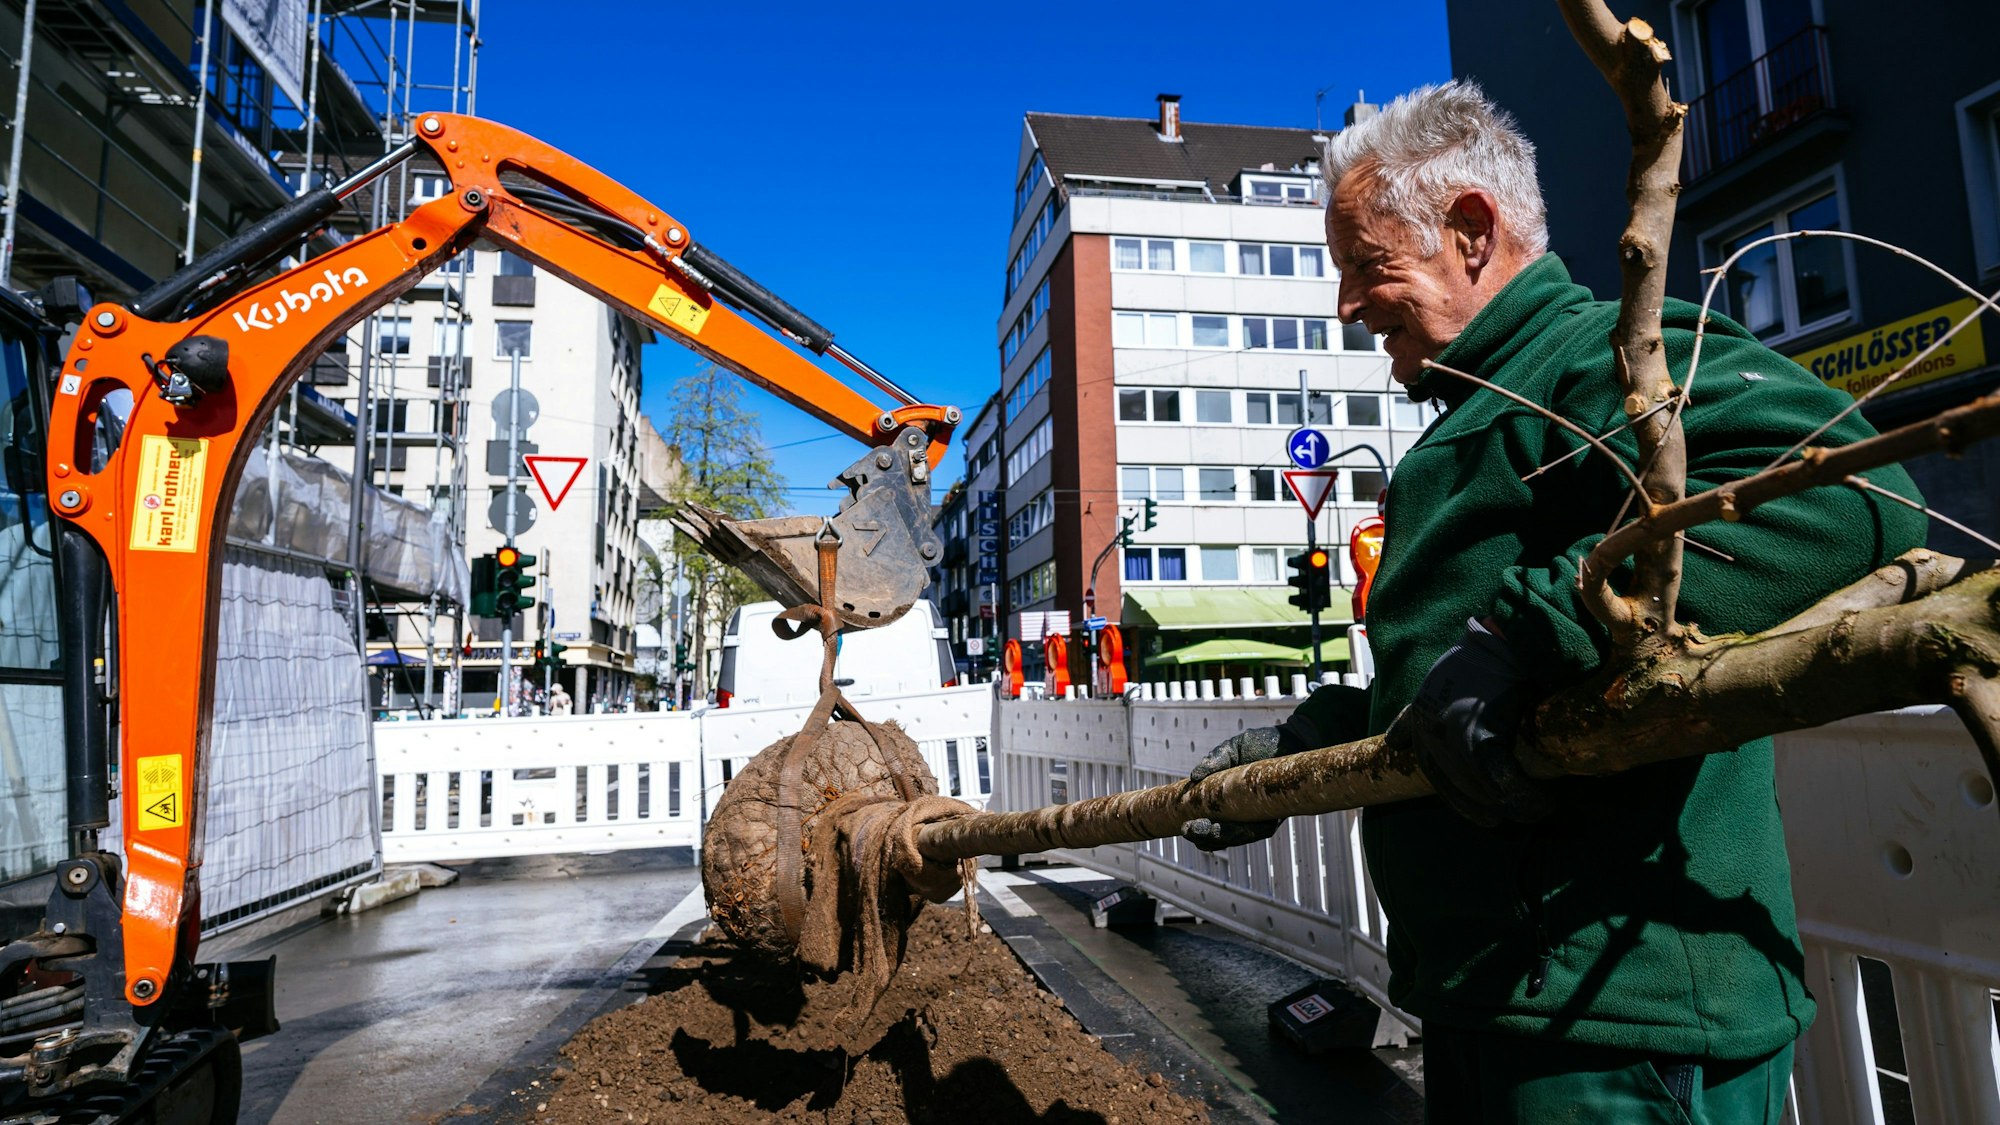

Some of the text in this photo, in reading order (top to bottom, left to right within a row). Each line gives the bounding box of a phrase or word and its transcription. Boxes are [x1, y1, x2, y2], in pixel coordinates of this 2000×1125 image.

[232, 267, 369, 333] Kubota
[1811, 316, 1952, 381] SCHLÖSSER
[164, 450, 181, 507] rother
[157, 511, 175, 546] karl
[980, 490, 997, 569] FISCH
